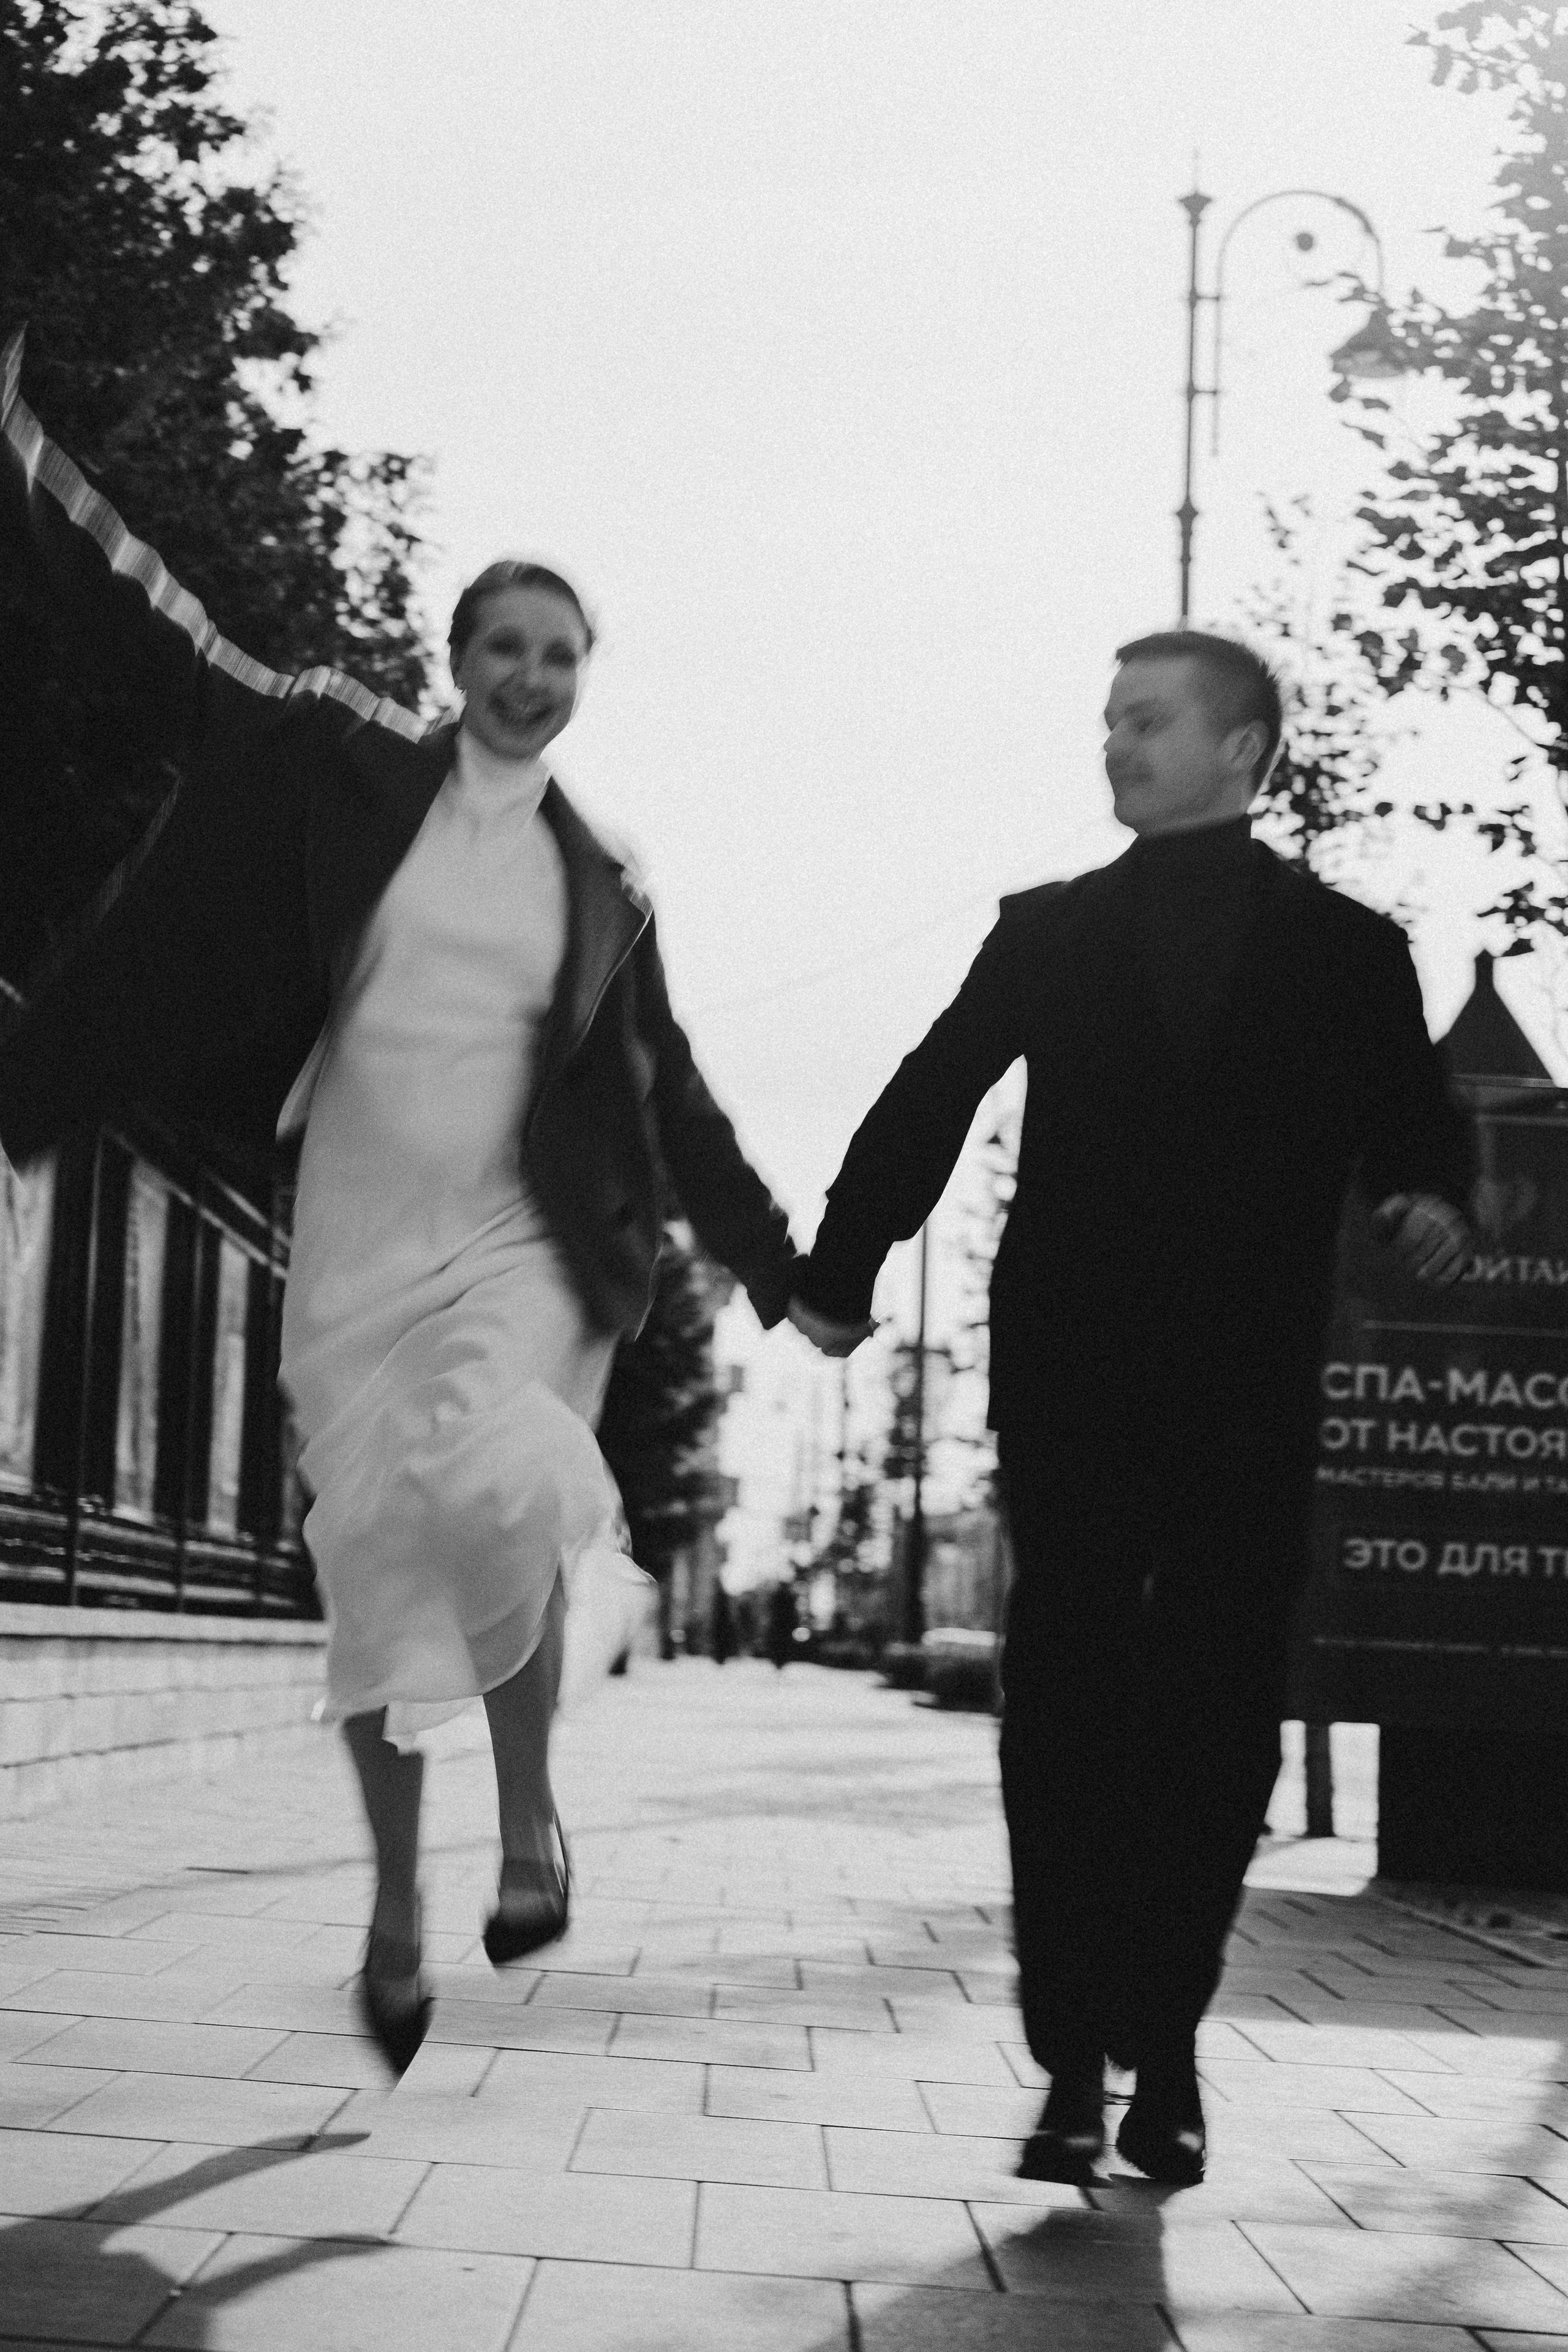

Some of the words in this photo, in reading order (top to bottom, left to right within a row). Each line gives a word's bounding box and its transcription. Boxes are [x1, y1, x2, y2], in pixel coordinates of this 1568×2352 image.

[1321, 1417, 1376, 1451] ОТ
[1387, 1420, 1566, 1460] НАСТОЯ
[1344, 1538, 1428, 1572] ЭТО
[1437, 1541, 1529, 1577] ДЛЯ
